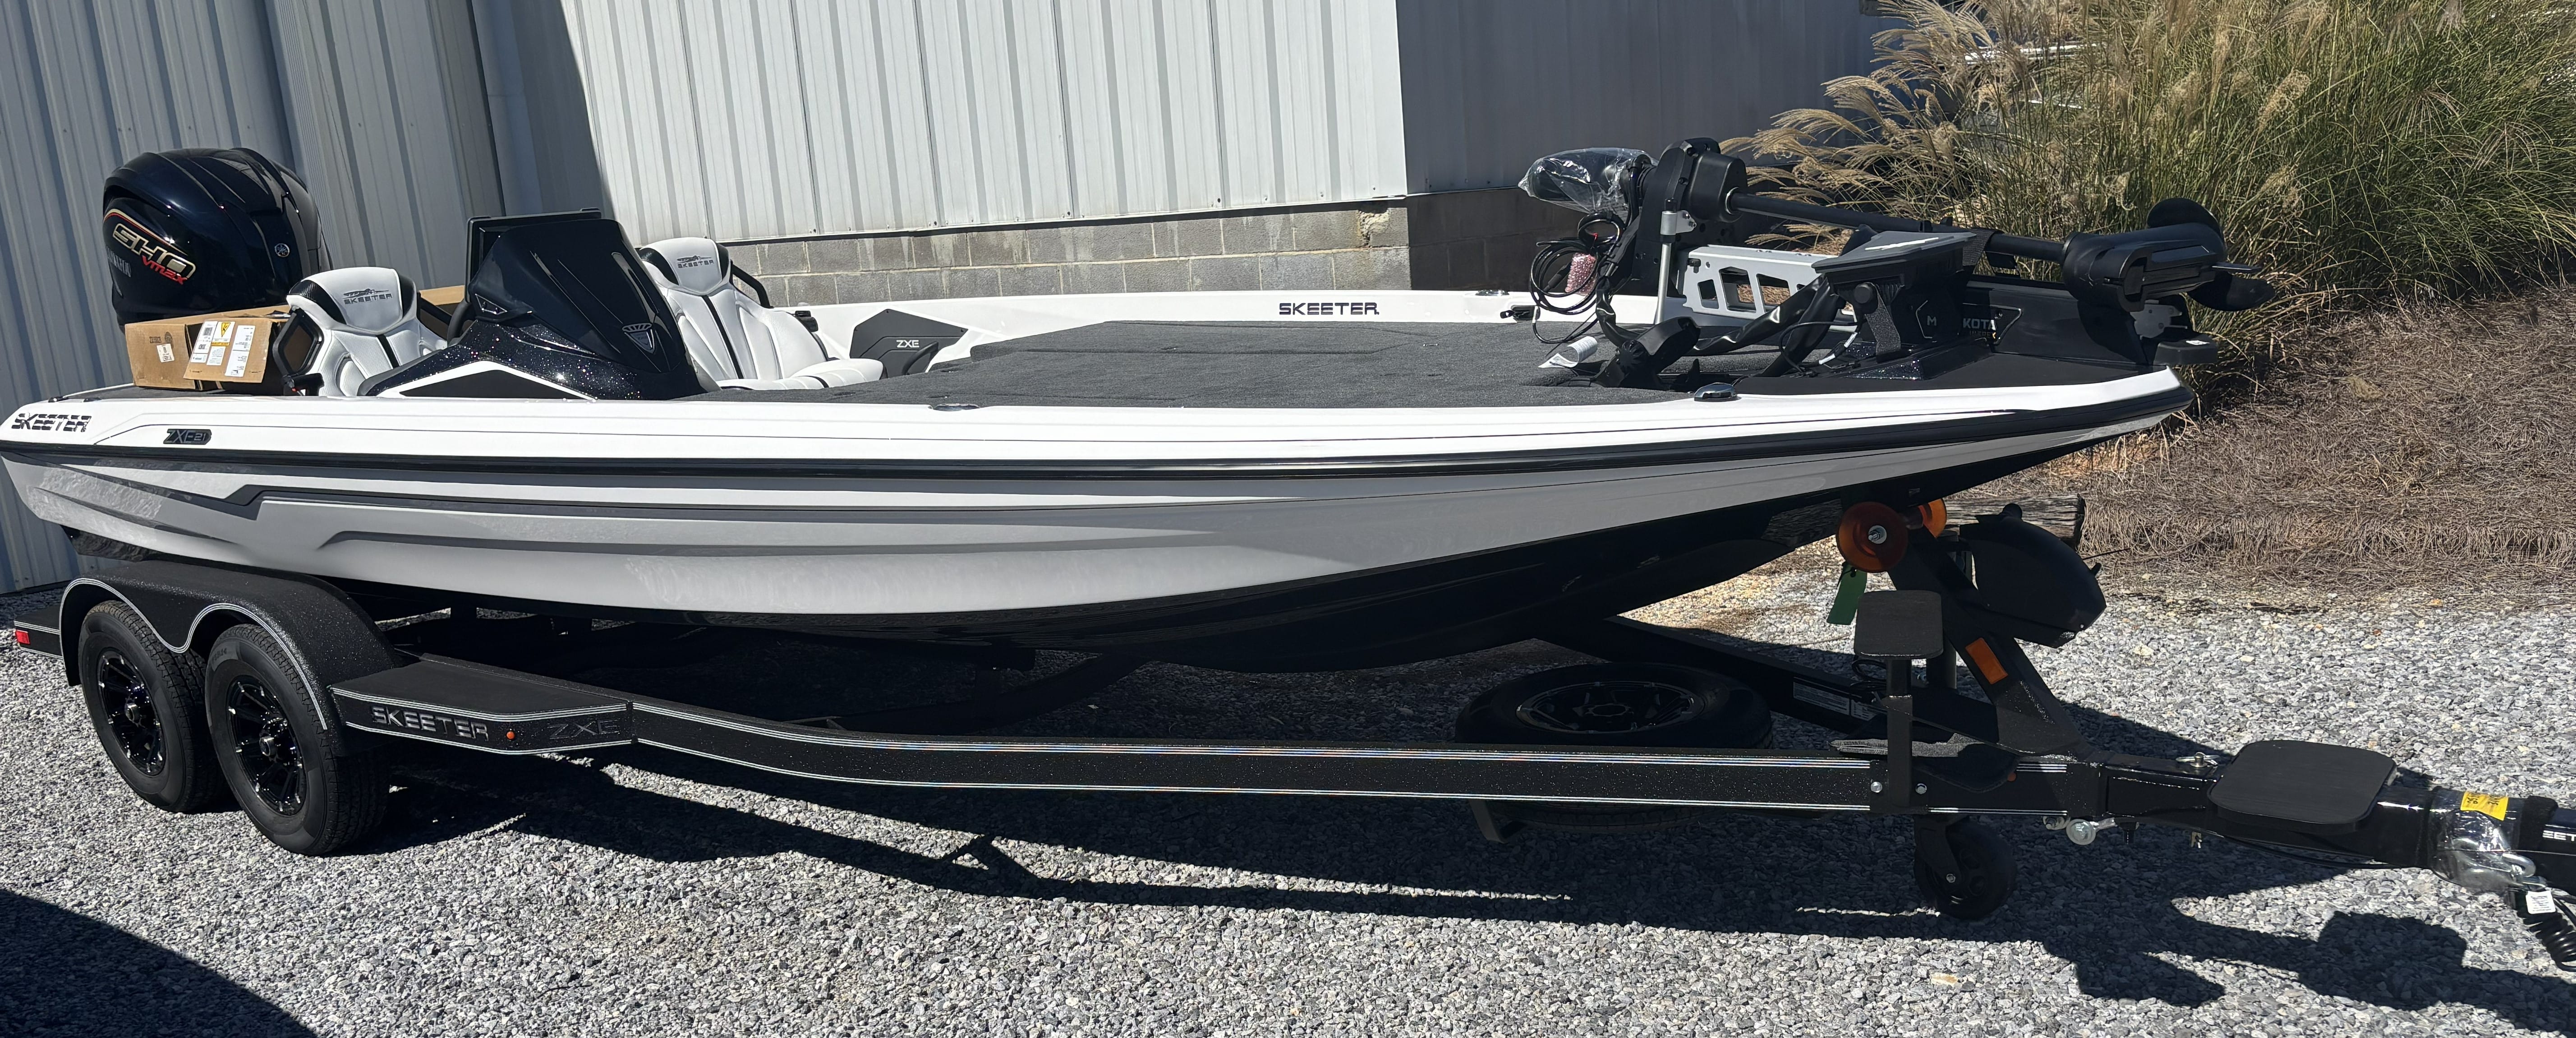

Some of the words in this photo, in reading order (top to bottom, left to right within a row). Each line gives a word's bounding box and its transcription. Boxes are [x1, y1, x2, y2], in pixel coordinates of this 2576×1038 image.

[113, 223, 196, 279] SHO
[677, 259, 714, 268] SKEETER
[344, 293, 393, 304] SKEETER
[1279, 302, 1379, 315] SKEETER
[1963, 318, 1996, 331] KOTA
[896, 339, 920, 348] ZXE
[11, 413, 92, 433] SKEETER
[372, 706, 489, 742] SKEETER
[547, 718, 621, 739] ZXE
